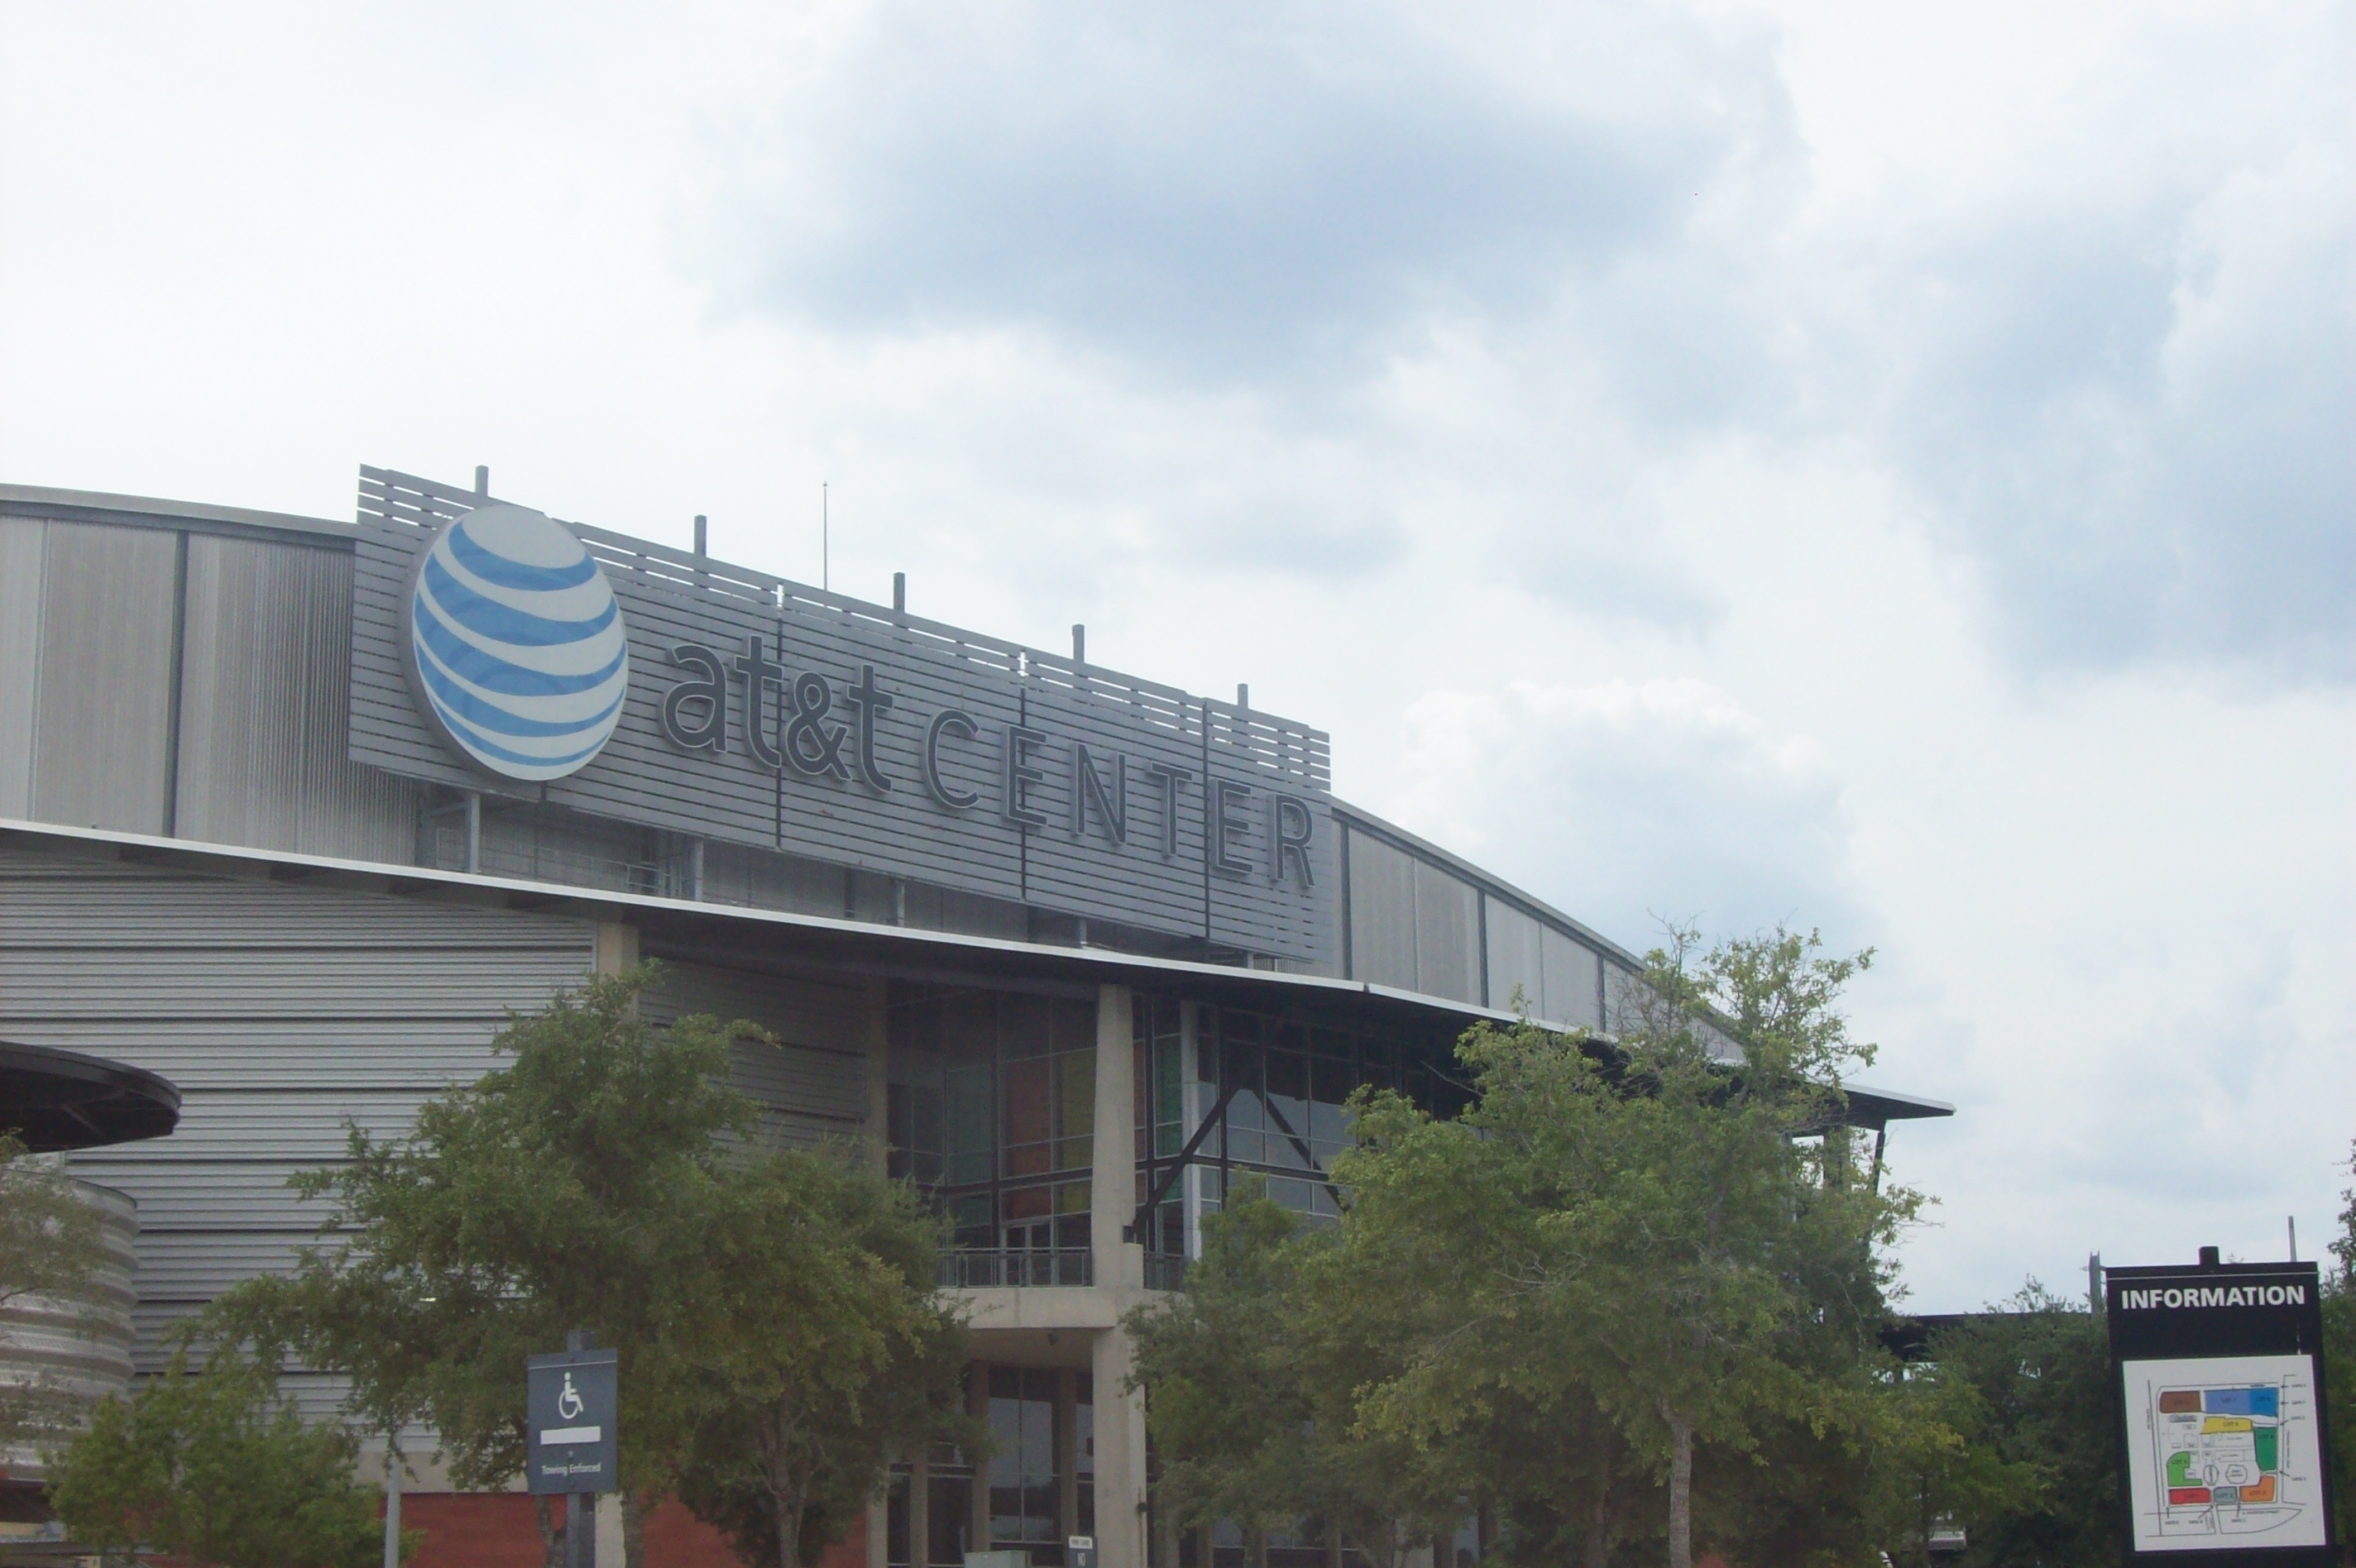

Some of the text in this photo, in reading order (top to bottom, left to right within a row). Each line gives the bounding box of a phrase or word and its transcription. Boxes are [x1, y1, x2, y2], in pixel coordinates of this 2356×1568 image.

[661, 633, 1315, 888] at&t CENTER
[2122, 1285, 2306, 1309] INFORMATION
[541, 1462, 602, 1476] Towing Enforced
